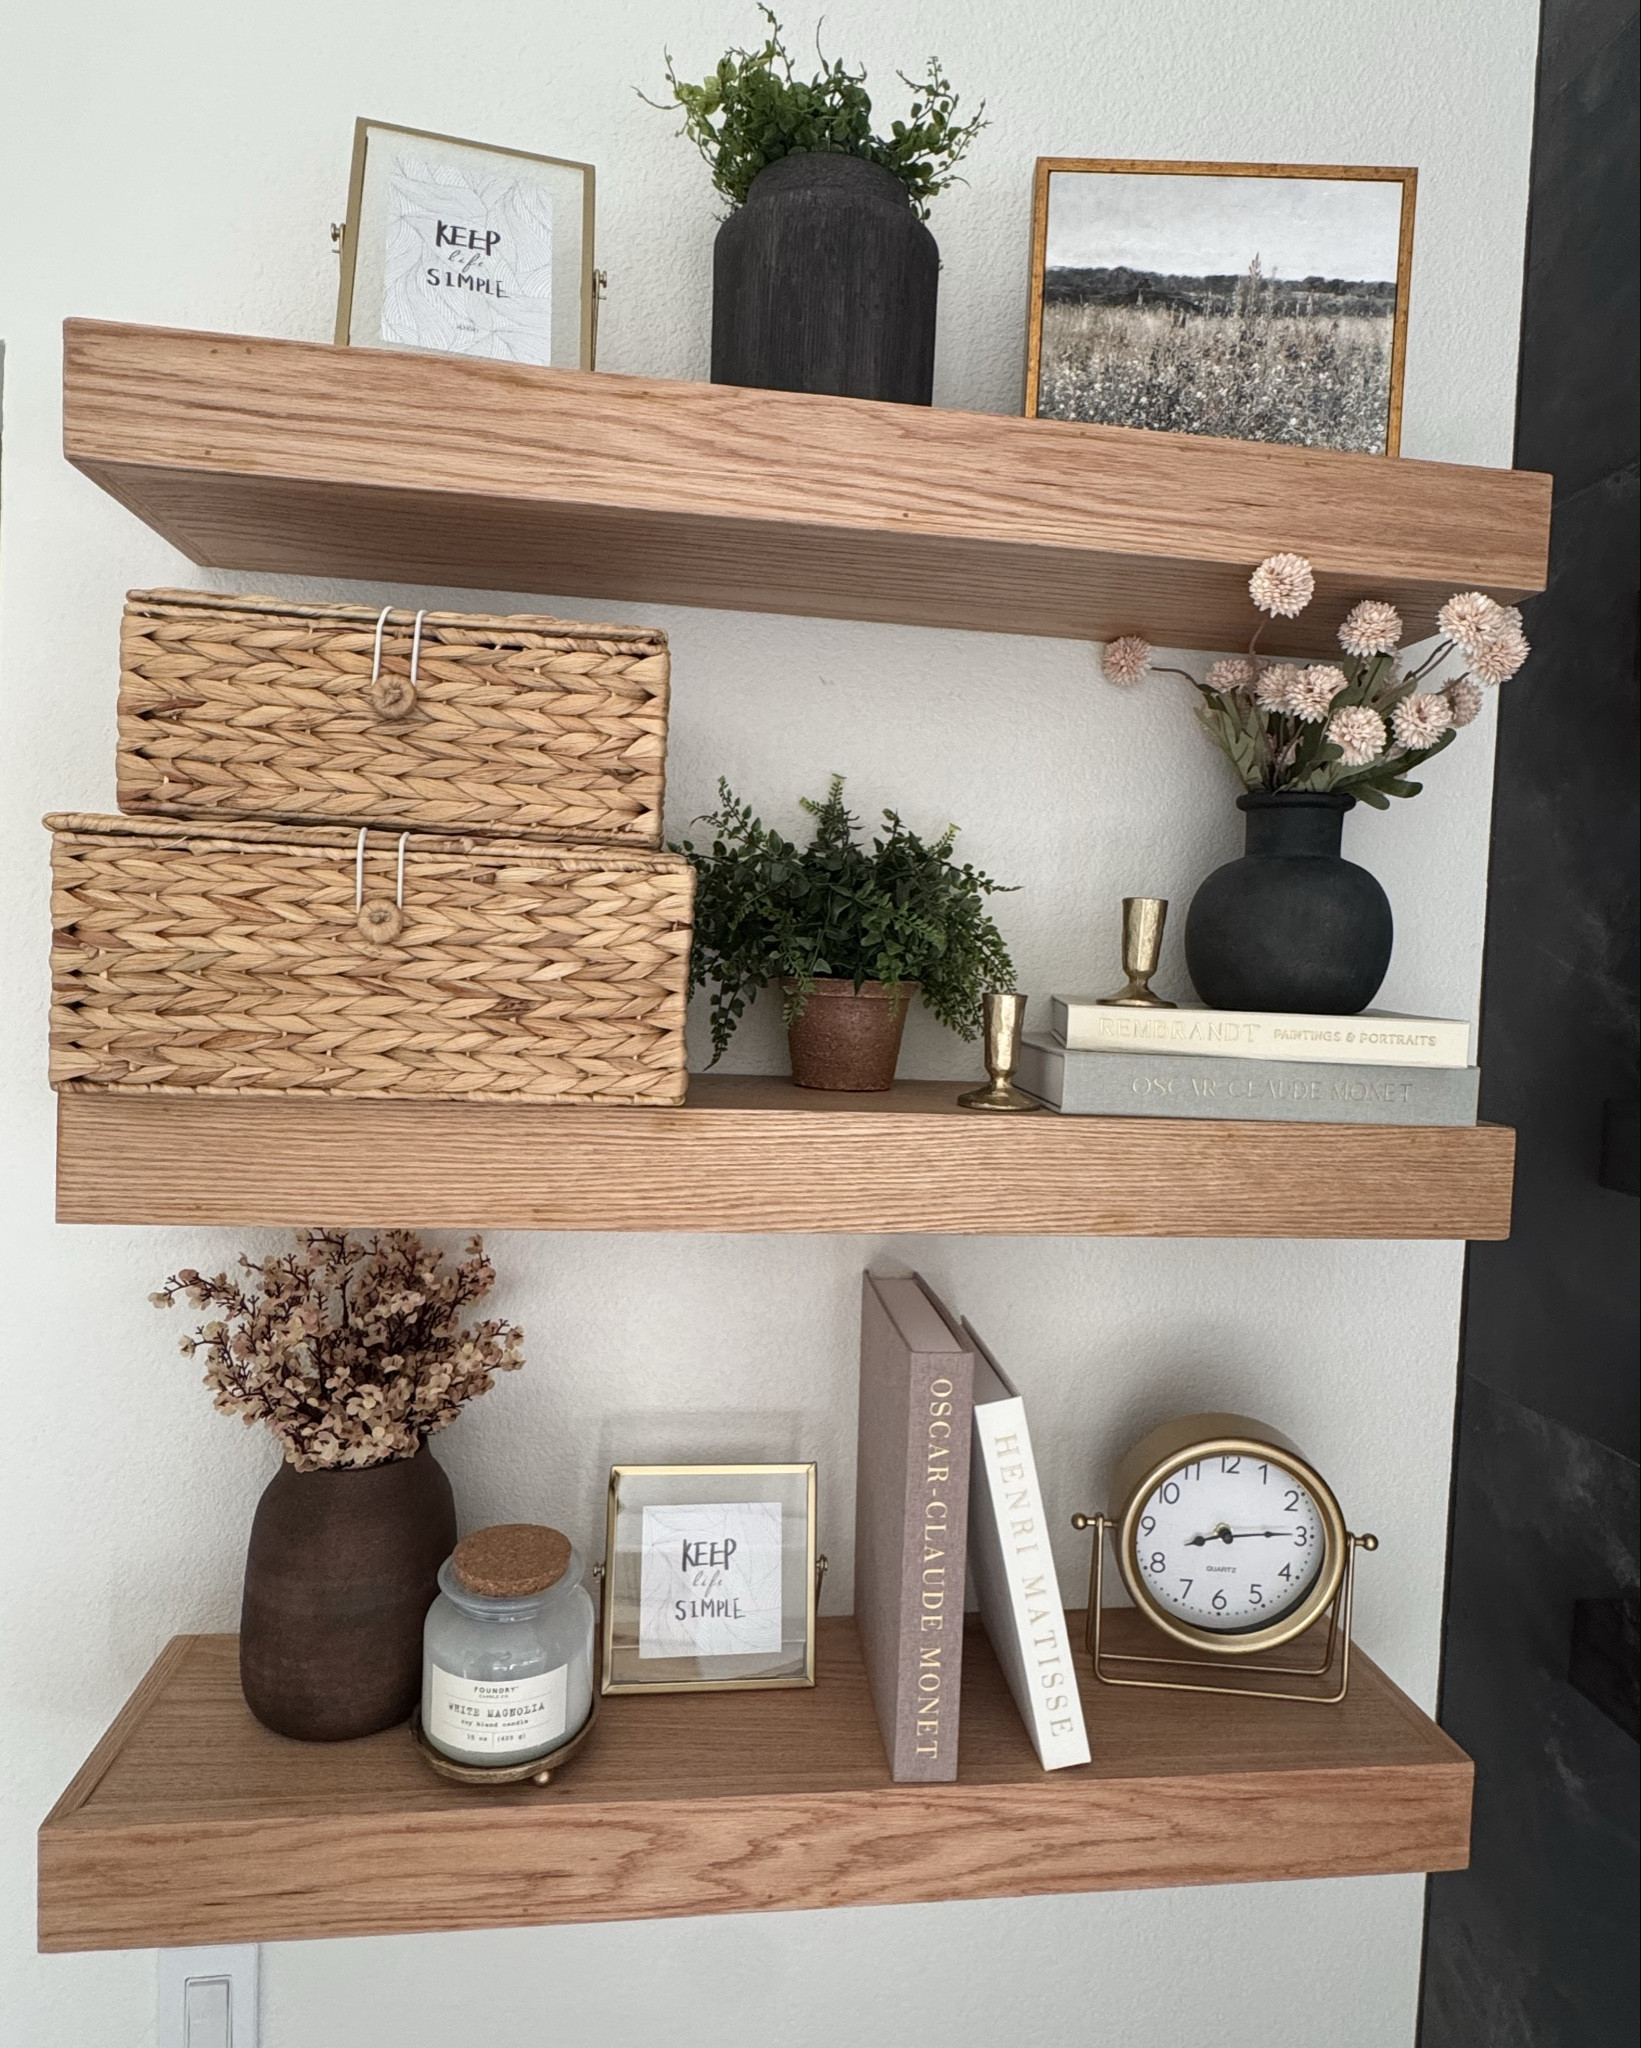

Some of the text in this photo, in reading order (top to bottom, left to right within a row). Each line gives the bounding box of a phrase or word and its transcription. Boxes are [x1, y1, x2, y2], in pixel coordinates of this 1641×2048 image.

[435, 219, 501, 256] KEEP
[448, 250, 484, 272] life
[426, 268, 510, 298] SIMPLE
[1098, 1017, 1437, 1047] REMBRANDT PAINTINGS & PORTRAITS
[1330, 1082, 1414, 1103] MONET
[1184, 1461, 1200, 1481] 11
[1221, 1456, 1241, 1474] 12
[1257, 1463, 1268, 1485] 1
[1158, 1482, 1180, 1504] 10
[1284, 1490, 1299, 1512] 2
[1140, 1516, 1156, 1537] 9
[1293, 1526, 1307, 1546] 3
[682, 1538, 738, 1572] KEEP
[1150, 1552, 1166, 1573] 8
[915, 1378, 953, 1760] OSCAR-CLAUDE MONET
[1206, 1565, 1237, 1573] QUARTZ
[1277, 1562, 1292, 1582] 4
[692, 1569, 722, 1597] life
[994, 1433, 1074, 1737] HENRI MATISSE
[1179, 1578, 1194, 1599] 7
[1211, 1589, 1227, 1610] 6
[1248, 1584, 1263, 1604] 5
[675, 1598, 746, 1621] SIMPLE
[474, 1686, 518, 1694] FOUNDRY
[449, 1702, 545, 1718] WHITE MAGNOLIA
[502, 1719, 529, 1727] candle
